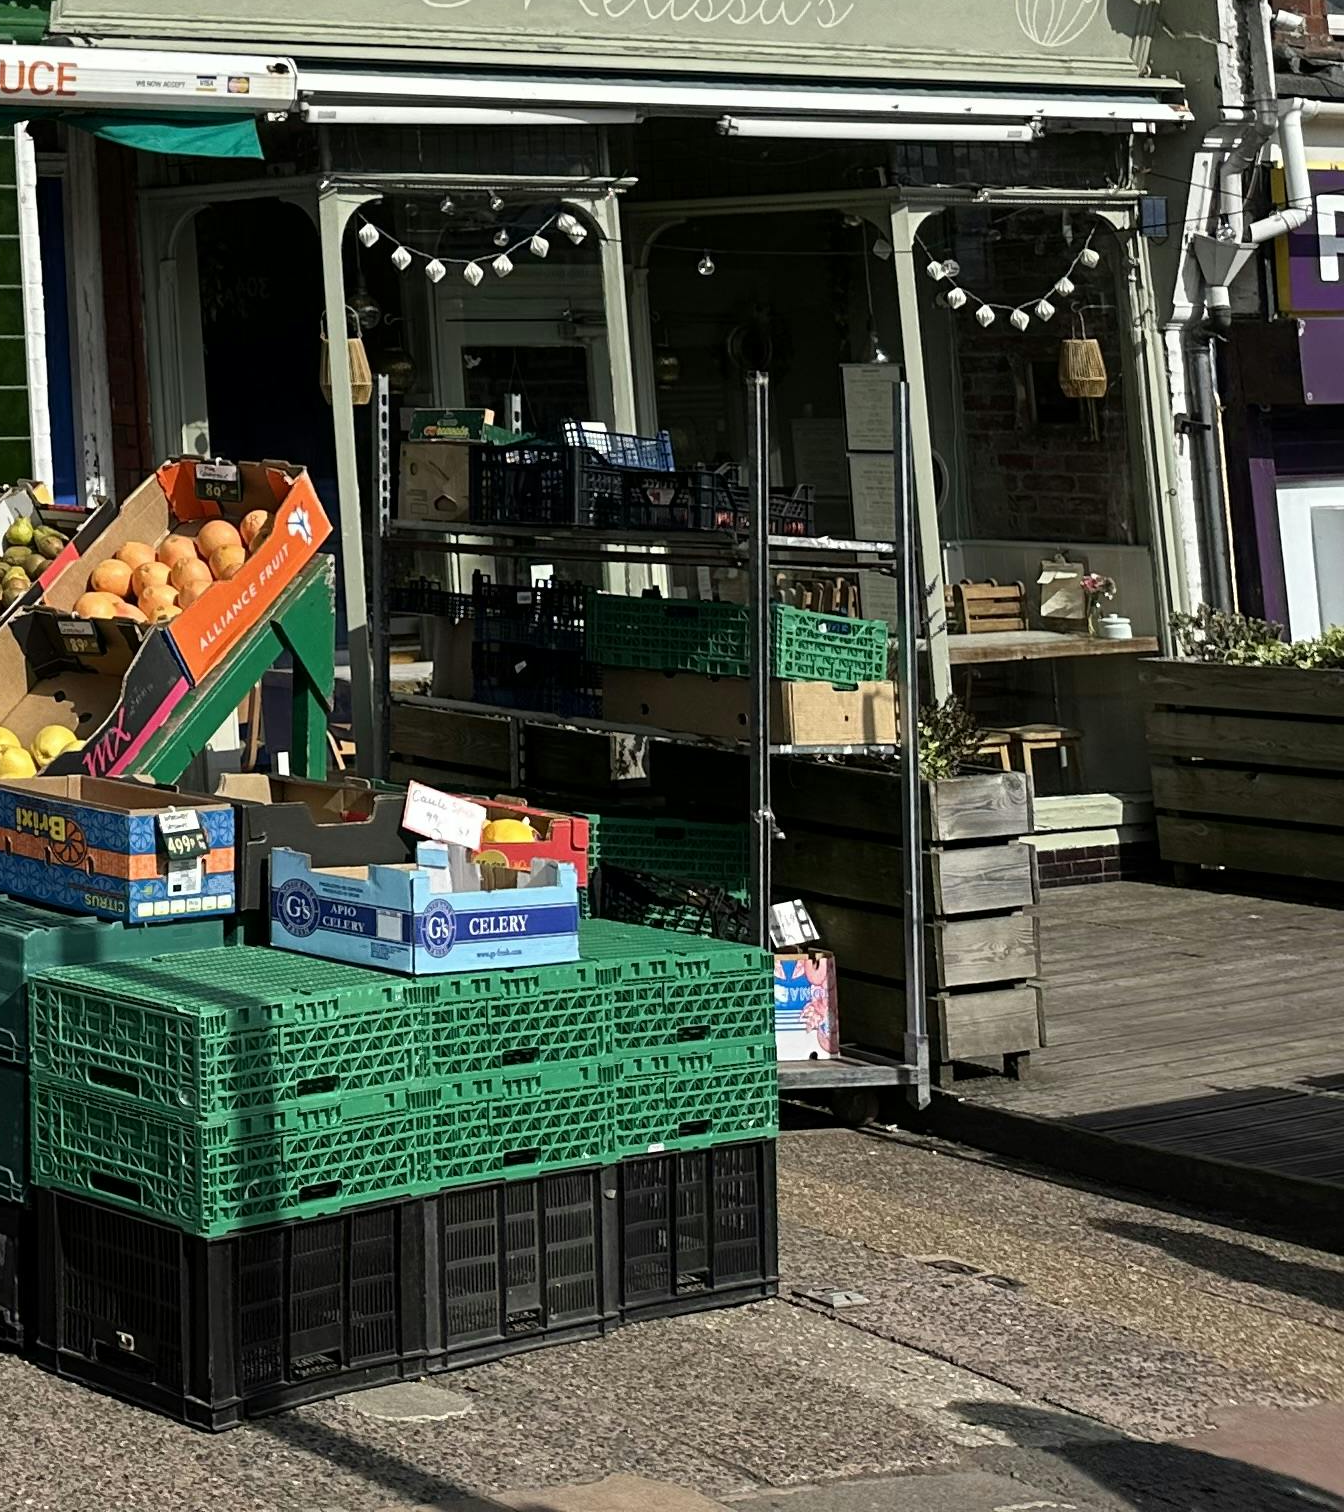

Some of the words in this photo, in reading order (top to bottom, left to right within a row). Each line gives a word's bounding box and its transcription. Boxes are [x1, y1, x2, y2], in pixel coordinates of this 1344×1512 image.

[198, 584, 258, 652] ALLIANCE
[258, 543, 290, 587] FRUIT
[15, 807, 66, 842] Brixi
[84, 893, 125, 913] CITRUS
[330, 904, 357, 918] APIO
[322, 917, 365, 933] CELERY
[469, 914, 529, 936] CELERY
